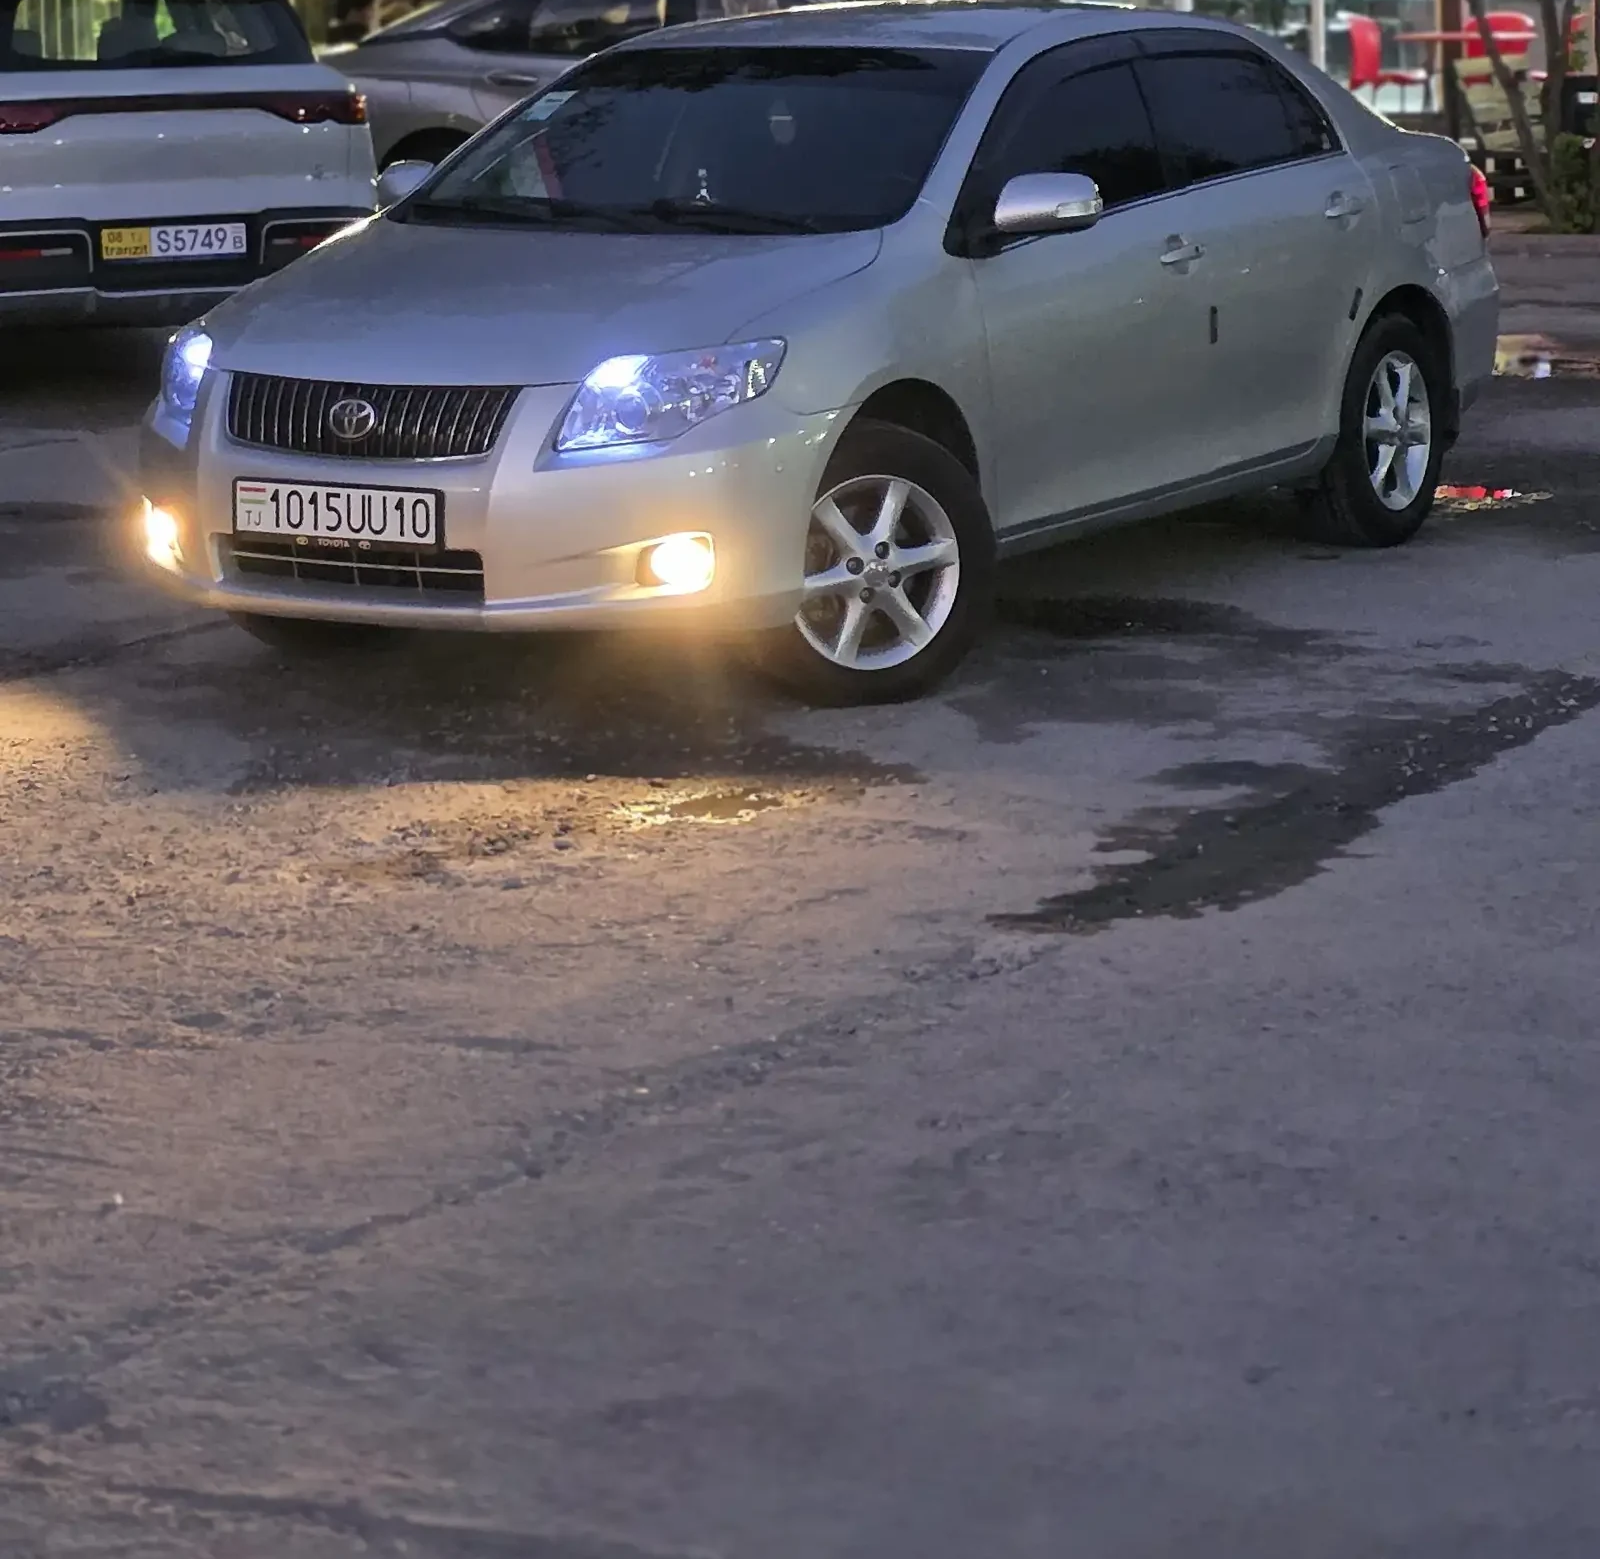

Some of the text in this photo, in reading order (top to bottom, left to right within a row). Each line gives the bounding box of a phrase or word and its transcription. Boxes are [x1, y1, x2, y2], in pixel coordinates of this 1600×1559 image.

[157, 227, 228, 253] S5749
[104, 244, 148, 256] tranzit
[245, 510, 262, 526] TJ
[270, 488, 430, 539] 1015UU10
[317, 538, 350, 548] TOYOTA
